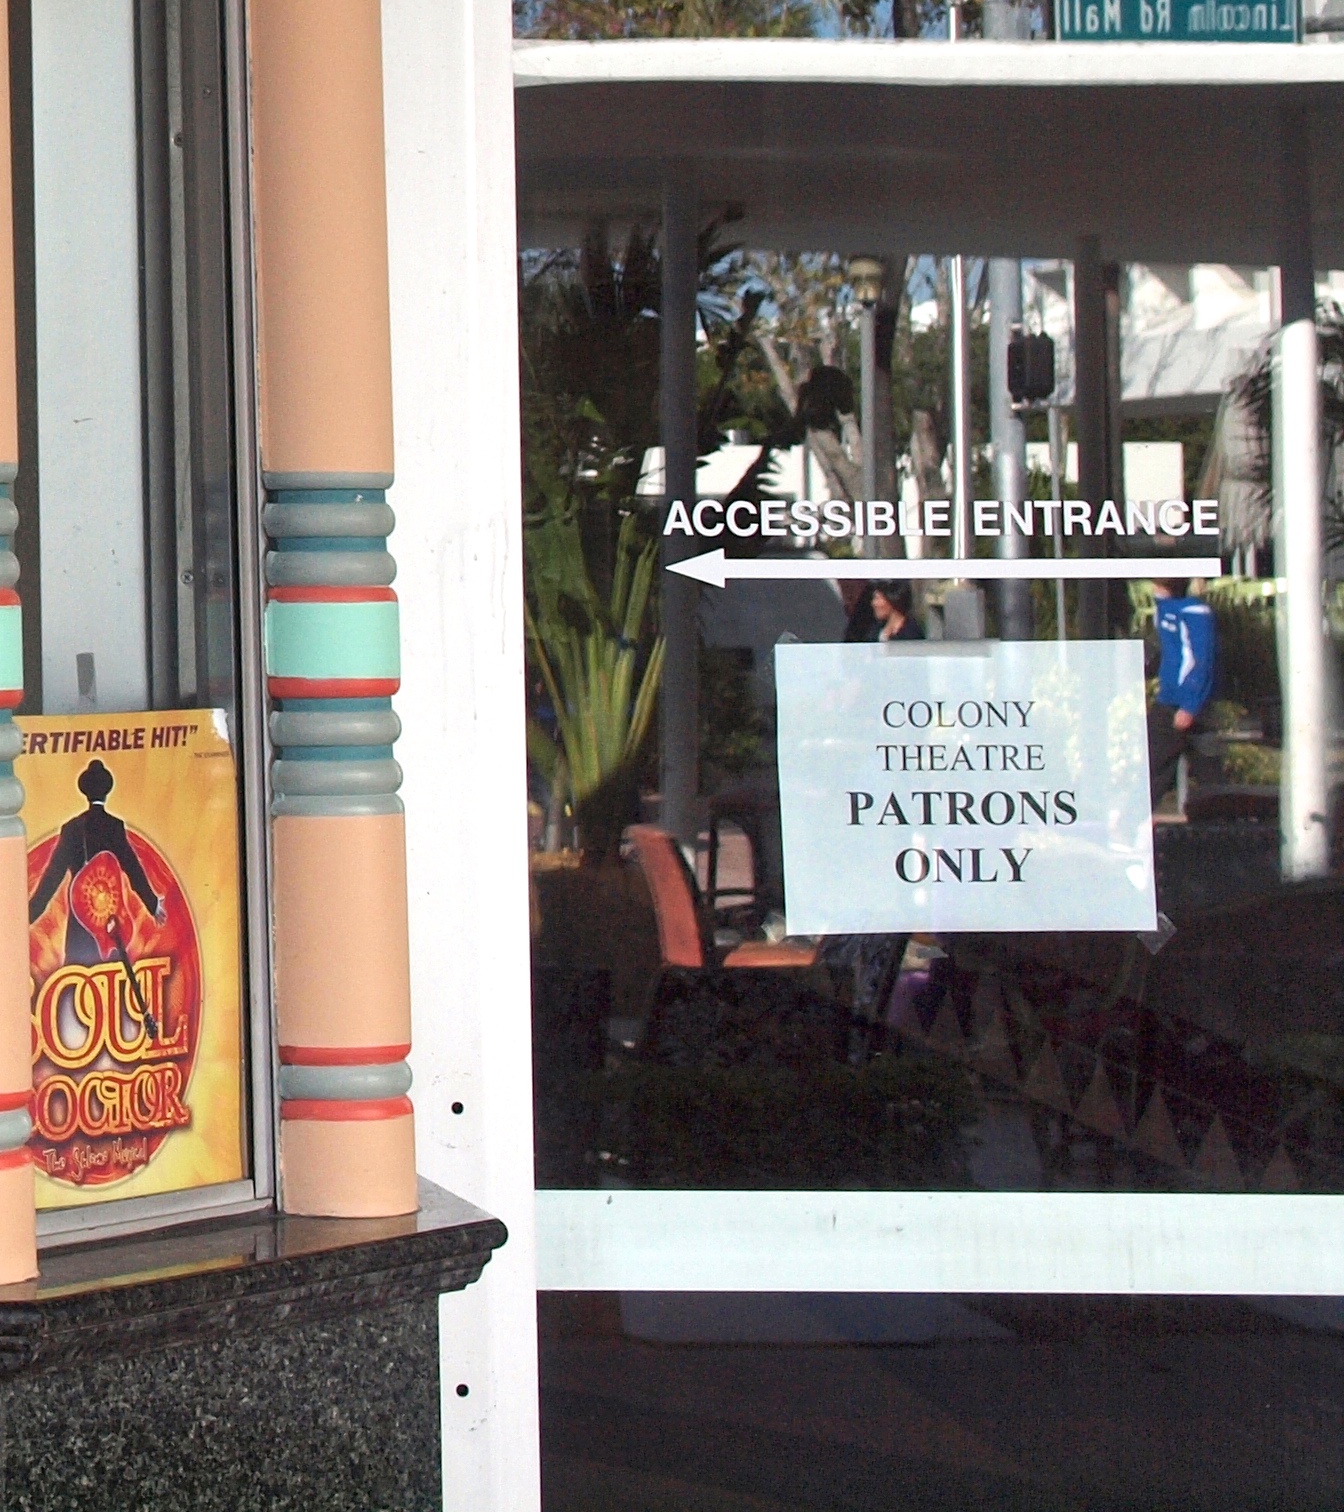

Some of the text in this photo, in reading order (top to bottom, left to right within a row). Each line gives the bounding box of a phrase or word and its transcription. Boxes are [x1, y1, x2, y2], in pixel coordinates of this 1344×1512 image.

[662, 498, 1219, 538] ACCESSIBLE ENTRANCE
[881, 700, 1036, 729] COLONY
[21, 727, 146, 754] RTIFIABLE
[876, 744, 1047, 772] THEATRE
[847, 790, 1078, 826] PATRONS
[894, 848, 1034, 883] ONLY
[33, 956, 189, 1069] OUL
[33, 1061, 192, 1143] OCTOR
